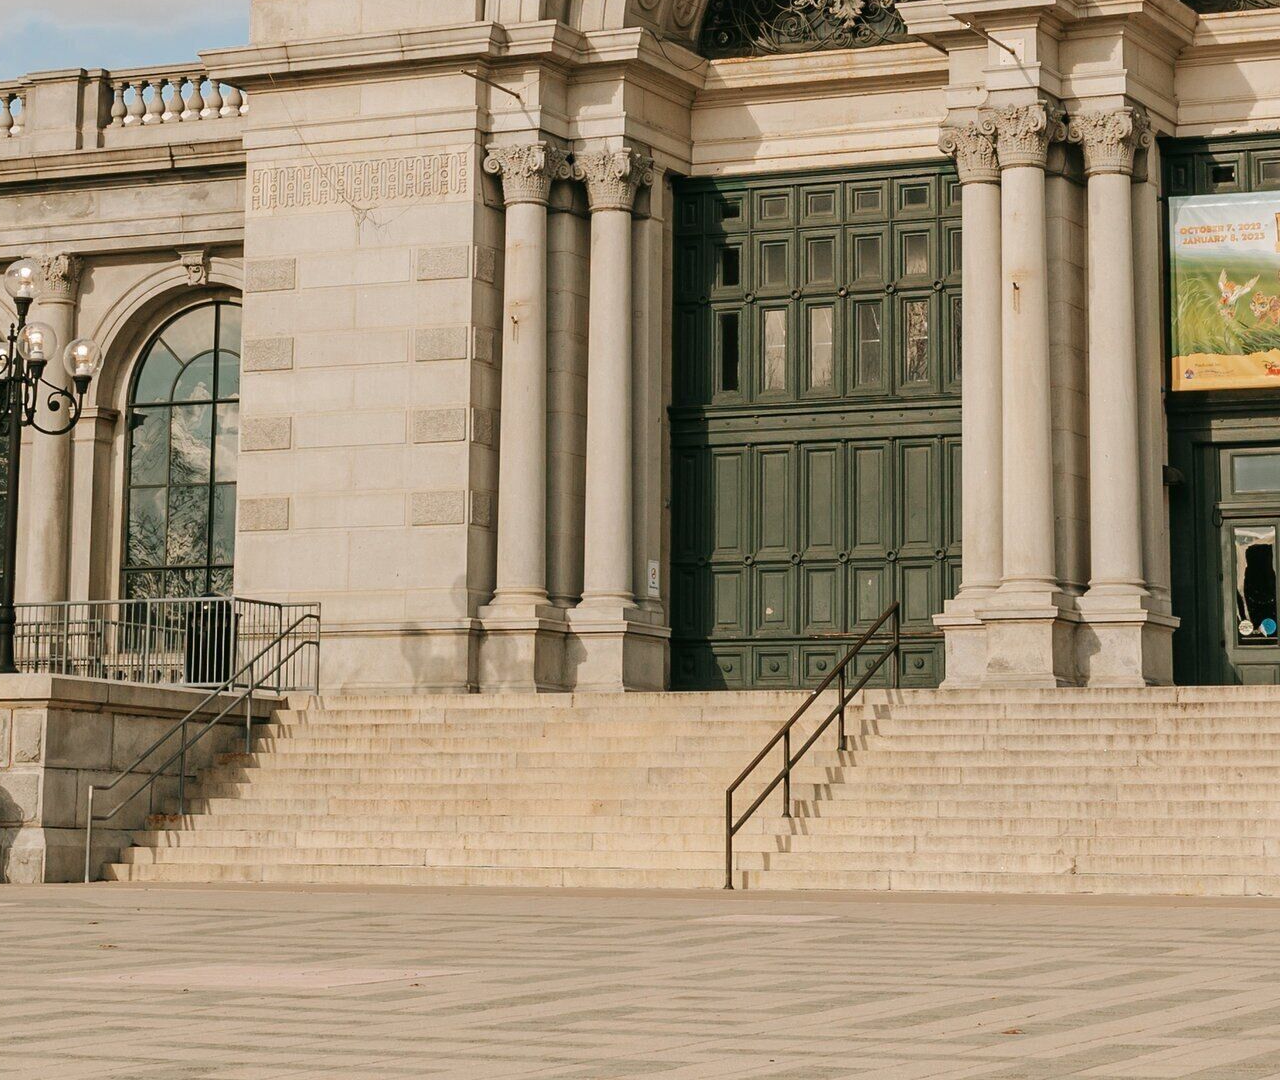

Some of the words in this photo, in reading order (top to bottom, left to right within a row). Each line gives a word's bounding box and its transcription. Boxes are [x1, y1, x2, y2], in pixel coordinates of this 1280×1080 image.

[1180, 225, 1224, 235] OCTOBER
[1183, 234, 1227, 244] JANUARY
[1241, 232, 1265, 241] 2023
